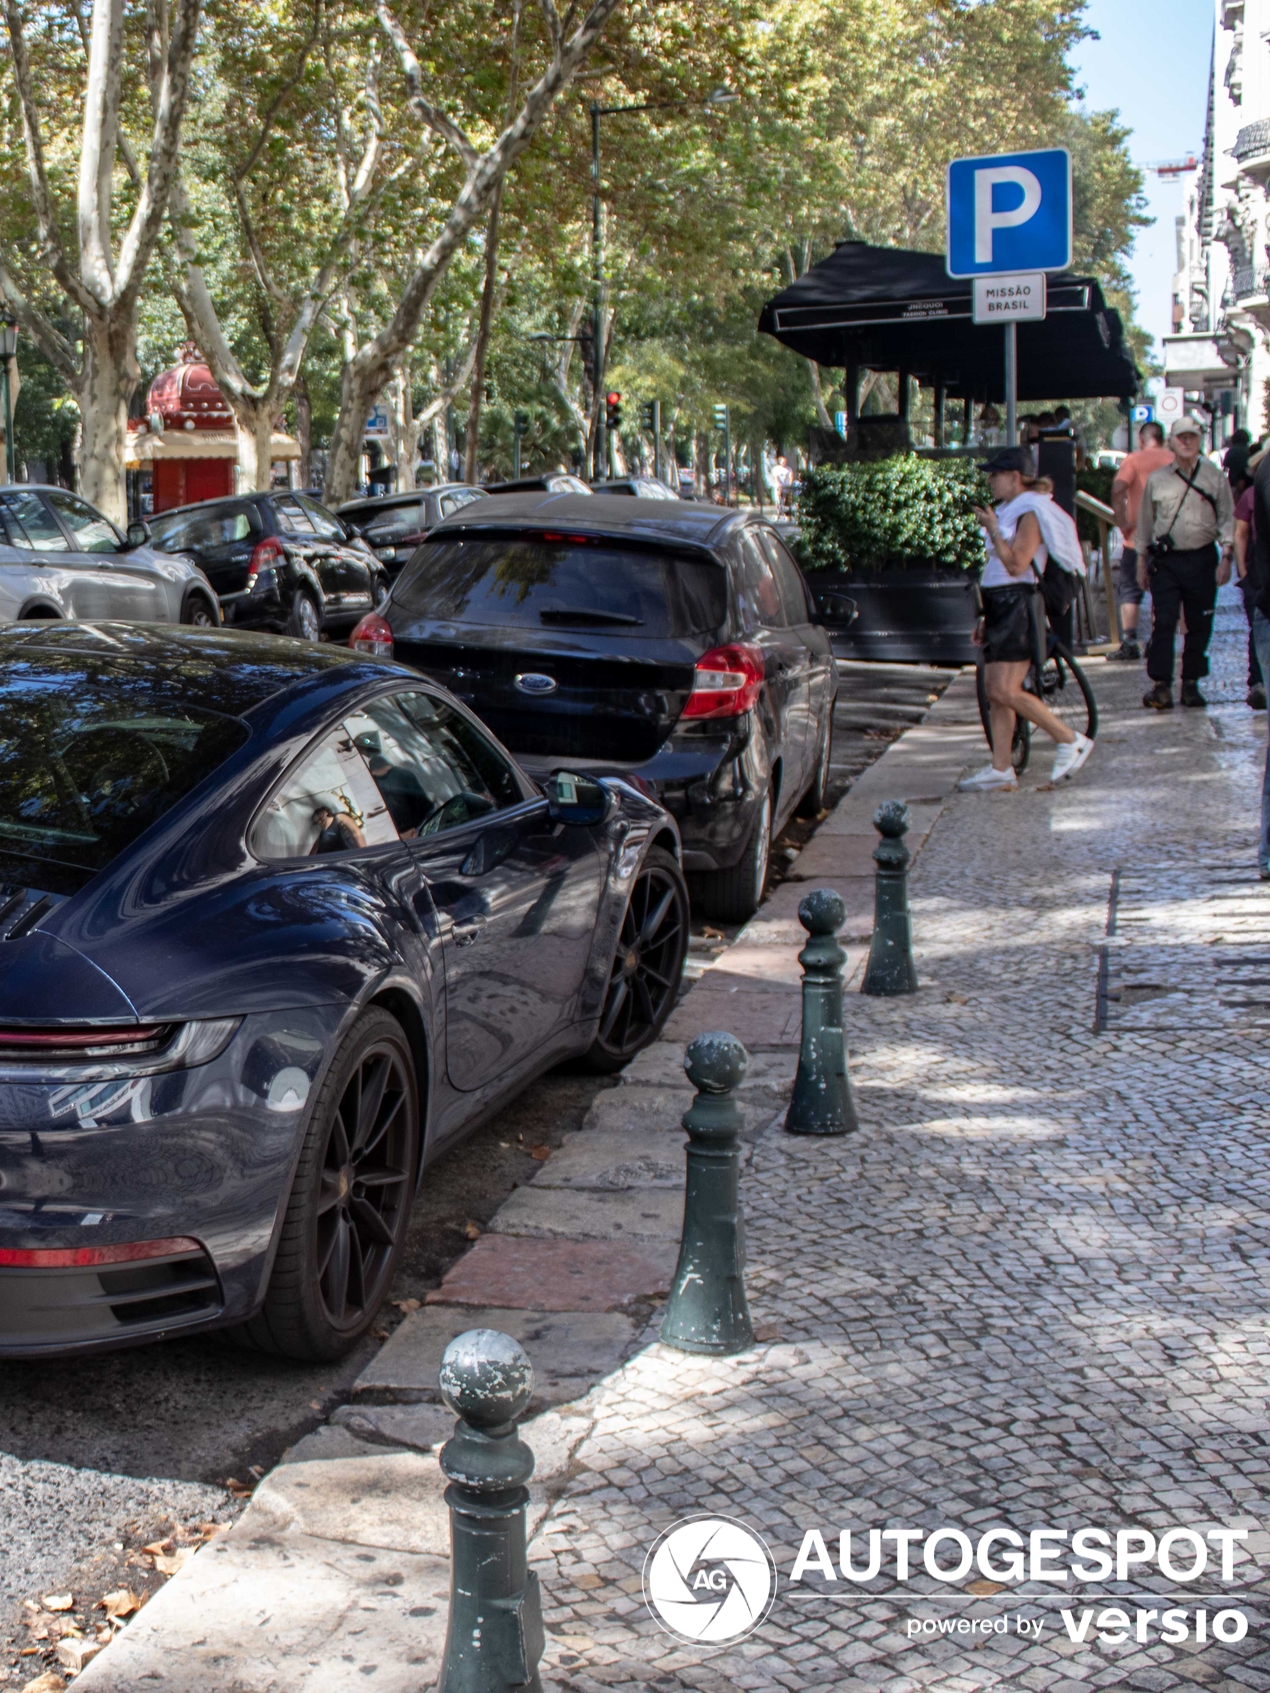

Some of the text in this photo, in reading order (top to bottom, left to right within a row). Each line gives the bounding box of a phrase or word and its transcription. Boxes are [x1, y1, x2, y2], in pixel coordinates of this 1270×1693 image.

[975, 165, 1042, 263] P
[986, 284, 1030, 298] MISSÃO
[988, 300, 1029, 312] BRASIL
